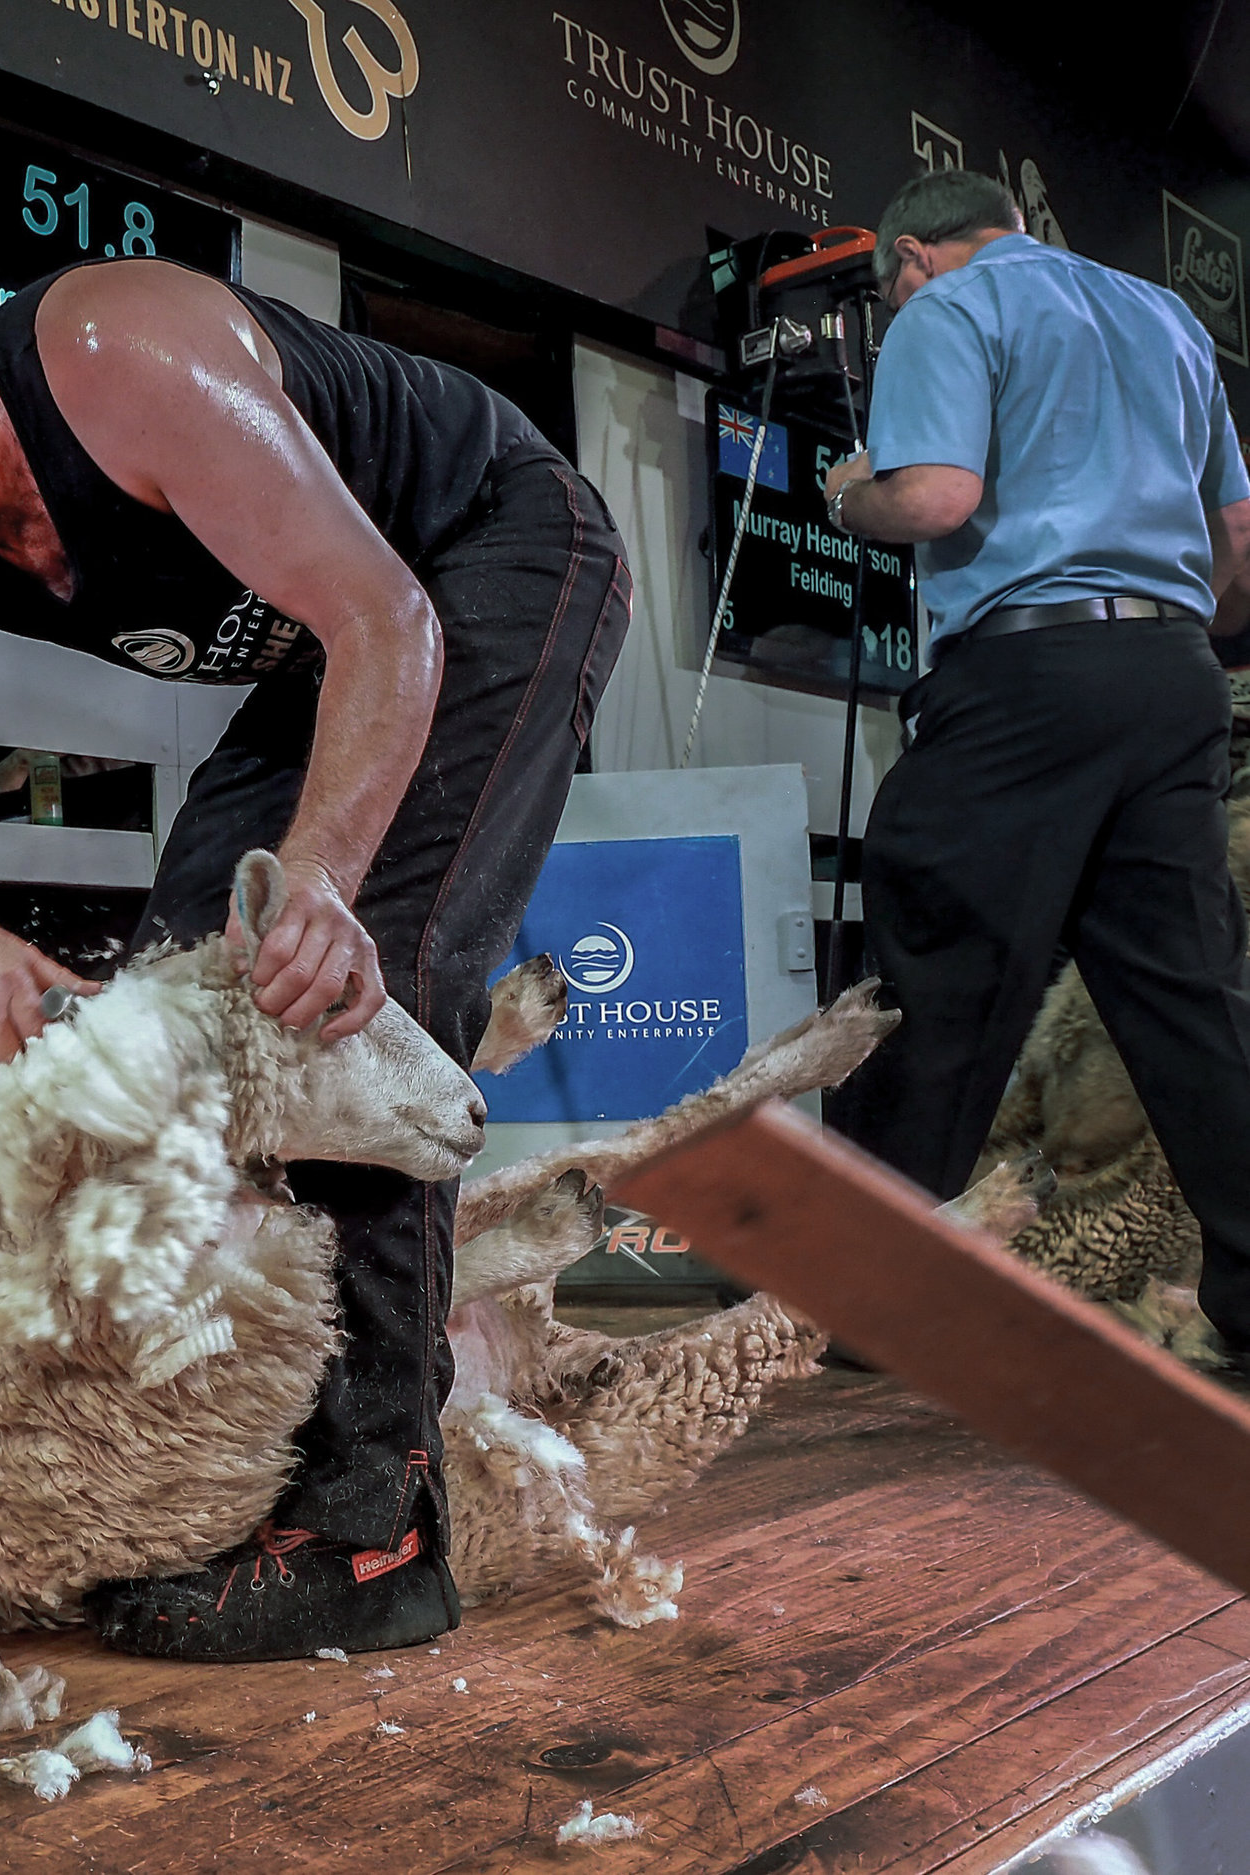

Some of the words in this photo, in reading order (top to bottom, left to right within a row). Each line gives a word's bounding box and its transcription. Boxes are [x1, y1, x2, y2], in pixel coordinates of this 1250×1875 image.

[55, 0, 294, 105] TERTON.NZ
[553, 12, 696, 126] TRUST
[704, 95, 833, 199] HOUSE
[567, 79, 702, 163] COMMUNITY
[716, 156, 829, 227] ENTERPRISE
[22, 164, 156, 256] 51.8
[1173, 226, 1237, 312] Lister
[733, 499, 801, 553] Murray
[806, 521, 900, 578] Hendeson
[791, 562, 852, 608] Feilding
[880, 623, 912, 671] 18
[599, 999, 722, 1025] HOUSE
[607, 1026, 716, 1040] ENTERPRISE
